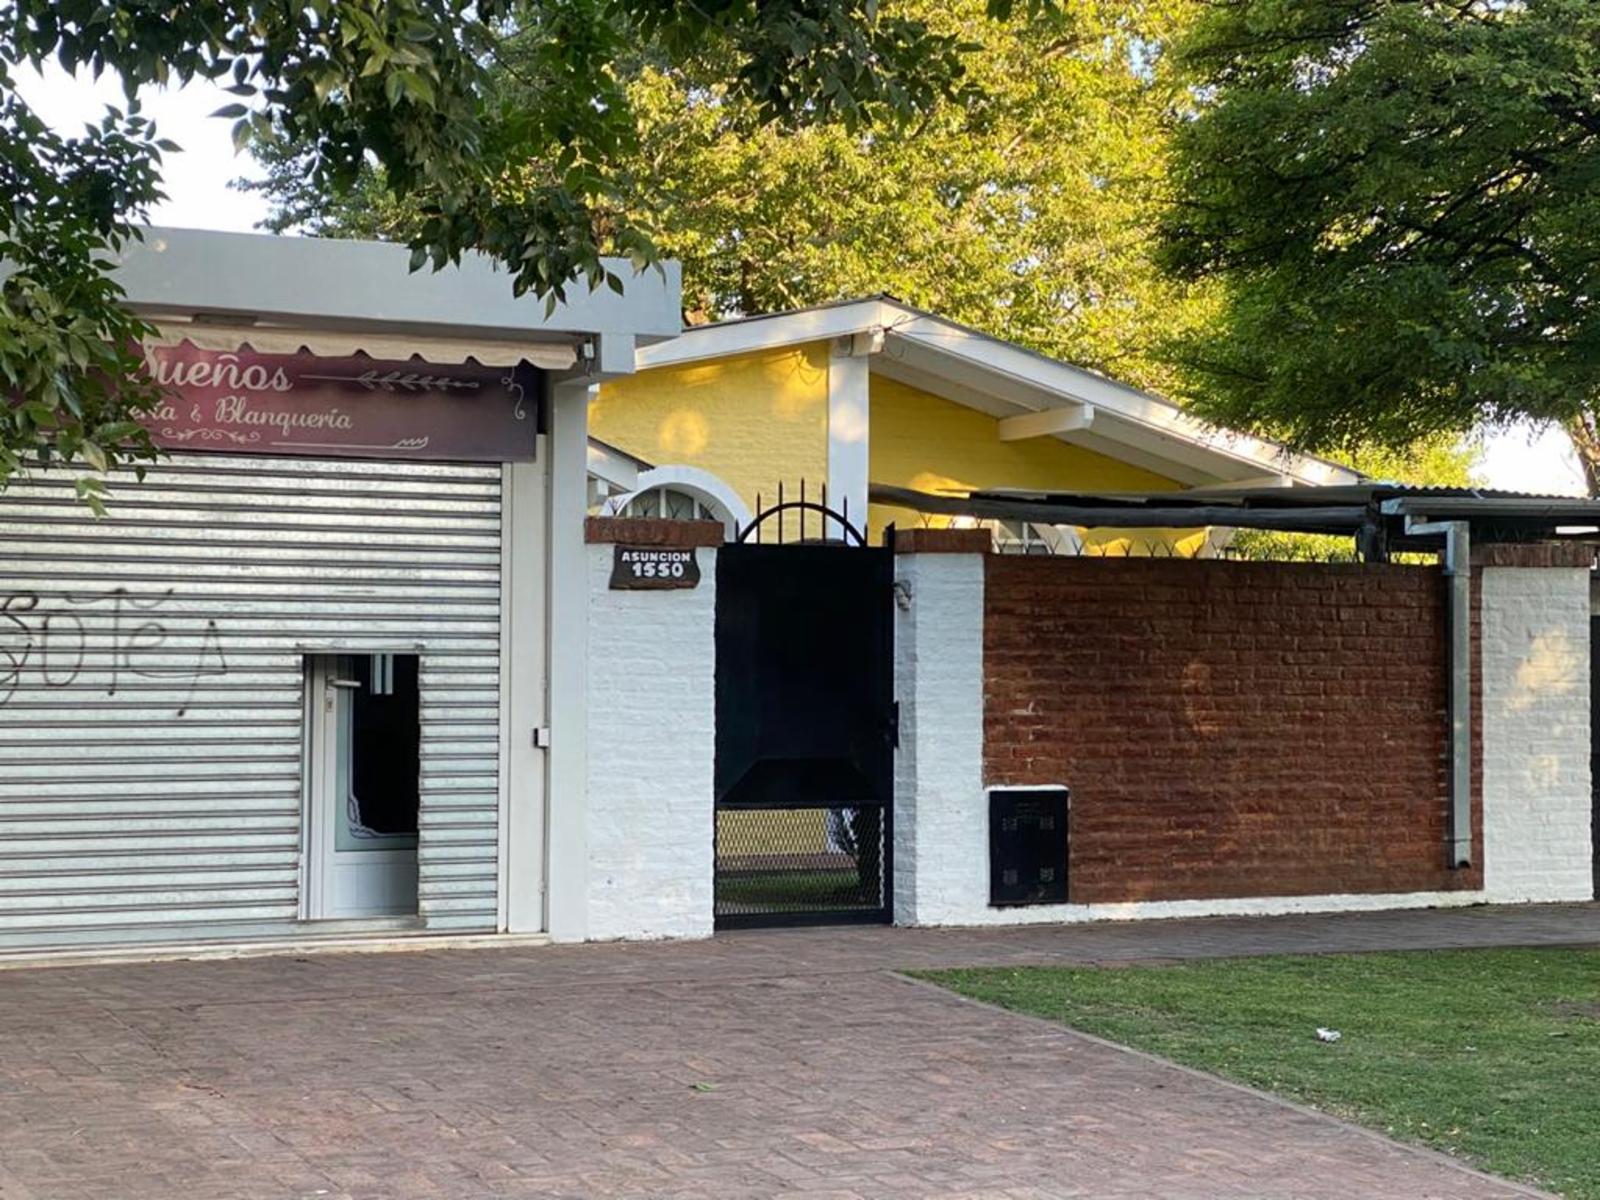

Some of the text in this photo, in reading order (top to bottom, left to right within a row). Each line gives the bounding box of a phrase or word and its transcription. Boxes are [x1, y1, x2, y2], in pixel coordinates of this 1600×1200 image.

[190, 402, 203, 423] &
[215, 395, 353, 436] Blanquería
[621, 551, 691, 562] ASUNCION
[632, 561, 684, 578] 1550
